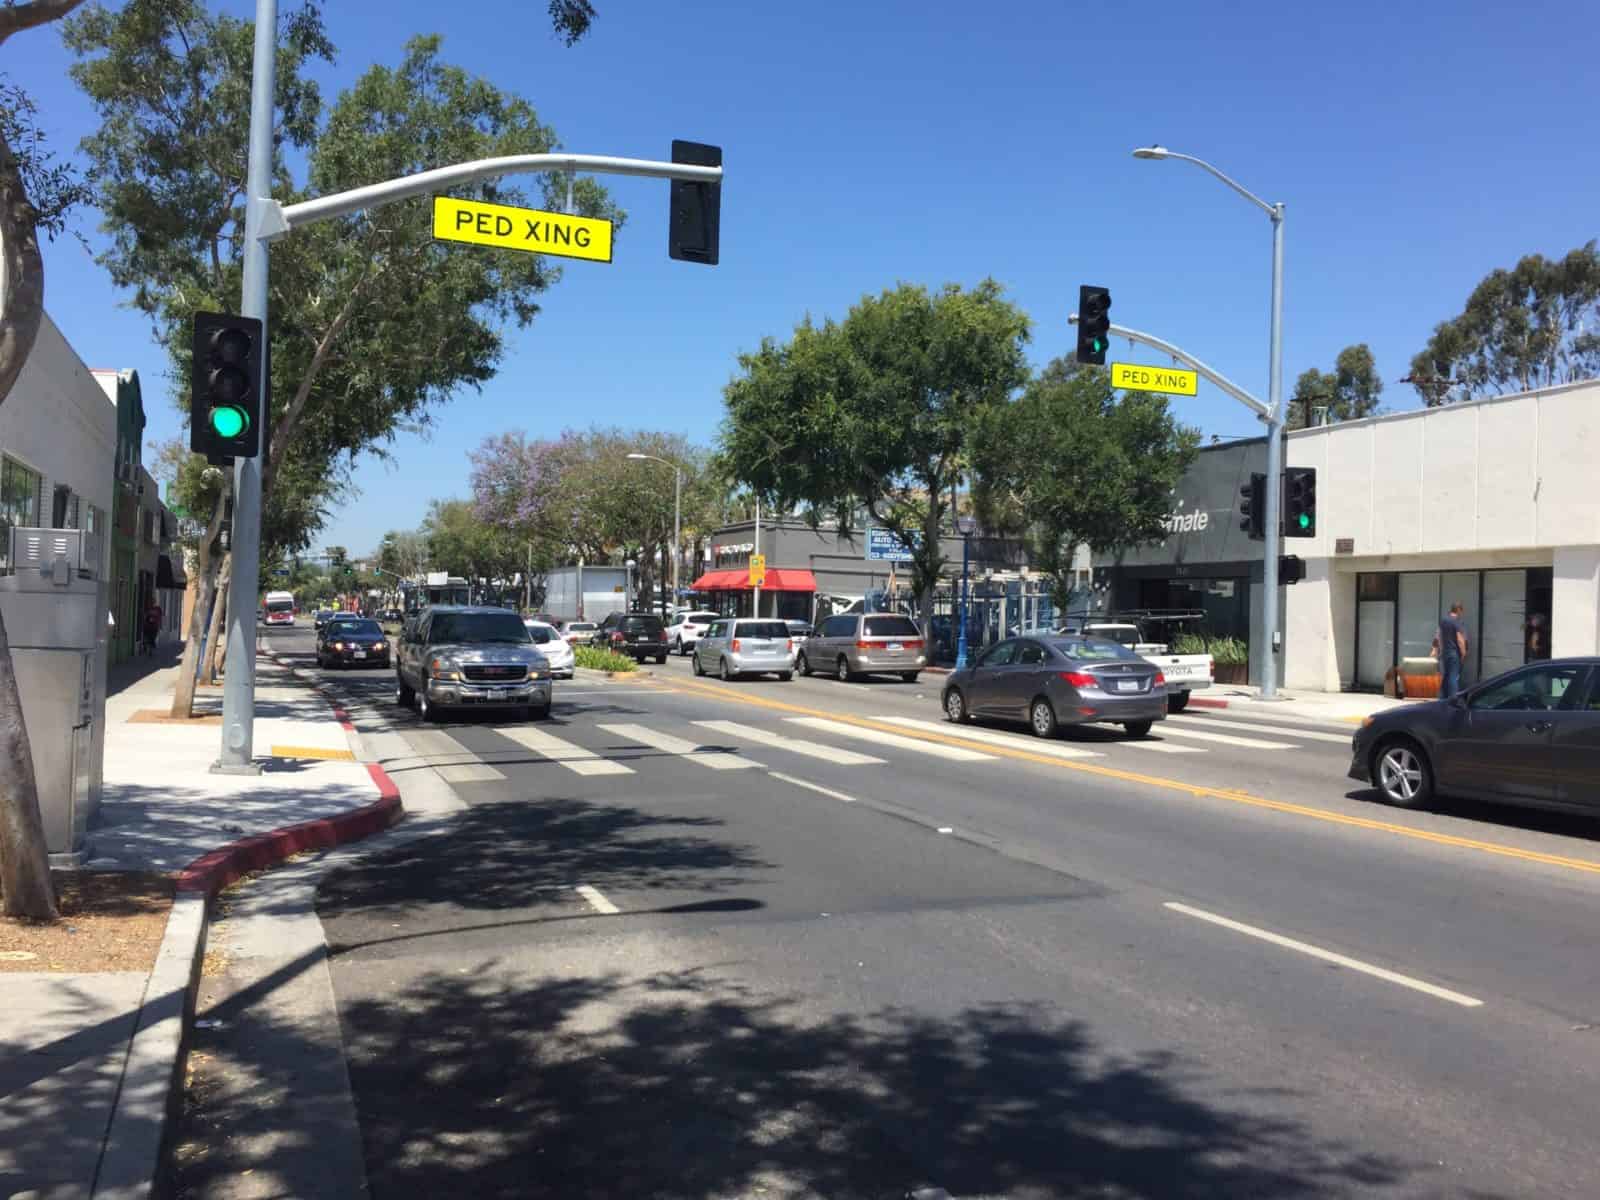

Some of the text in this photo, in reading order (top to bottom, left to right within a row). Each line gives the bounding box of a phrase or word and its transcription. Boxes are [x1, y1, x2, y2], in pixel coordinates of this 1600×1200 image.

[456, 210, 592, 248] PED XING
[1121, 369, 1187, 389] PED XING
